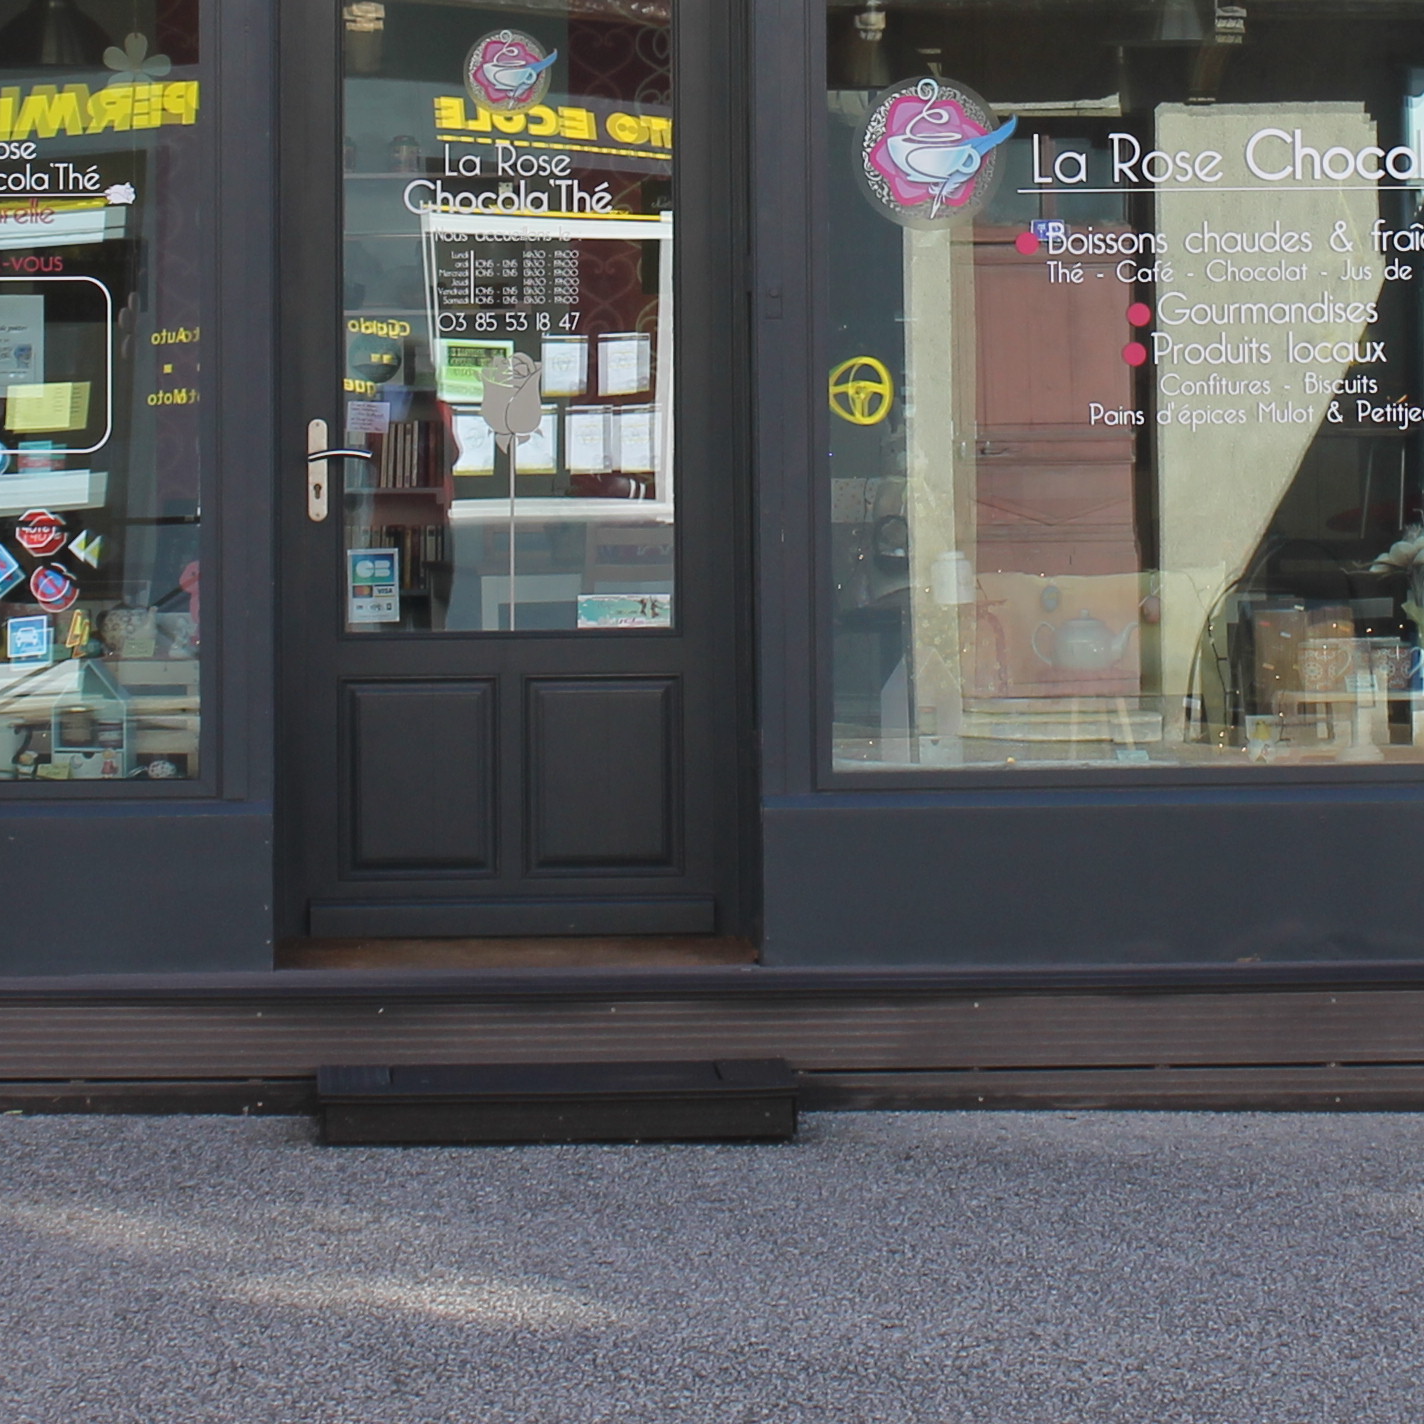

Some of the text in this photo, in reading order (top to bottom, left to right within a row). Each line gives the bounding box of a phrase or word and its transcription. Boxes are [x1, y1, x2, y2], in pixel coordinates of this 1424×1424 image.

[444, 143, 571, 176] La Rose
[1033, 134, 1086, 183] La
[1108, 133, 1223, 183] Rose
[403, 179, 613, 214] Chocola'Thé
[1048, 222, 1168, 255] Boissons
[1185, 221, 1312, 254] chaudes
[1331, 221, 1354, 252] &
[1047, 262, 1084, 284] Thé
[1116, 261, 1174, 284] Café
[1206, 261, 1307, 282] Chocolat
[1340, 261, 1372, 281] Jus
[1384, 260, 1413, 281] de
[437, 312, 580, 332] 03 85 53 18 47
[1157, 292, 1379, 326] Gourmandises
[1151, 331, 1387, 365] Produits locaux
[1160, 373, 1271, 396] Confitures
[1304, 372, 1378, 395] Biscuits
[1089, 403, 1145, 426] Pains
[1157, 401, 1247, 431] d'épices
[1258, 402, 1314, 423] Mulot
[1327, 402, 1344, 423] &
